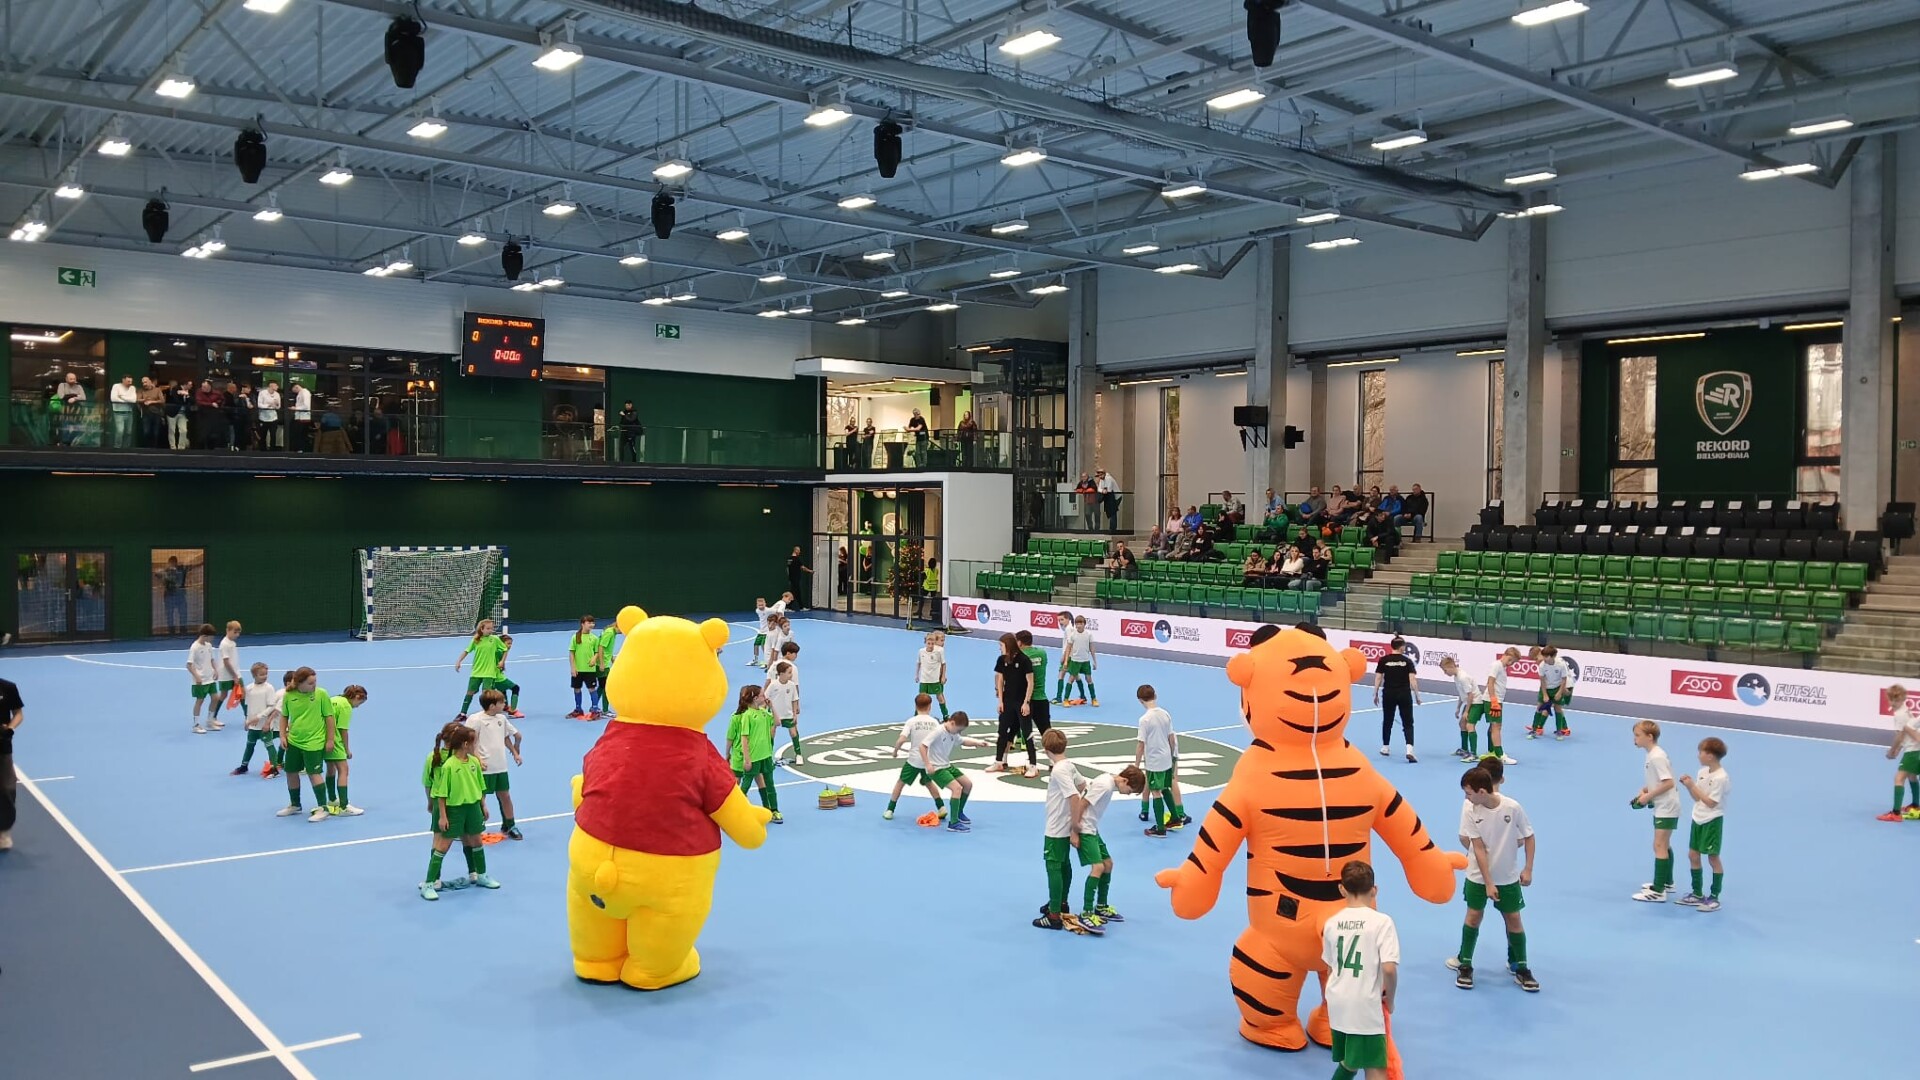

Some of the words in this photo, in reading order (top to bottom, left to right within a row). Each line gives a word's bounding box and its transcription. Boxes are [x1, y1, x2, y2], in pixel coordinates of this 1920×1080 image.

[472, 330, 480, 341] 0
[531, 335, 538, 346] 0
[468, 364, 475, 373] 0
[531, 368, 538, 377] 0
[1696, 440, 1750, 451] REKORD
[1583, 665, 1627, 679] FUTSAL
[1774, 683, 1828, 699] FUTSAL
[1773, 695, 1827, 706] EKSTRAKLASA
[1337, 920, 1366, 931] MACIEK
[1336, 934, 1363, 978] 14
